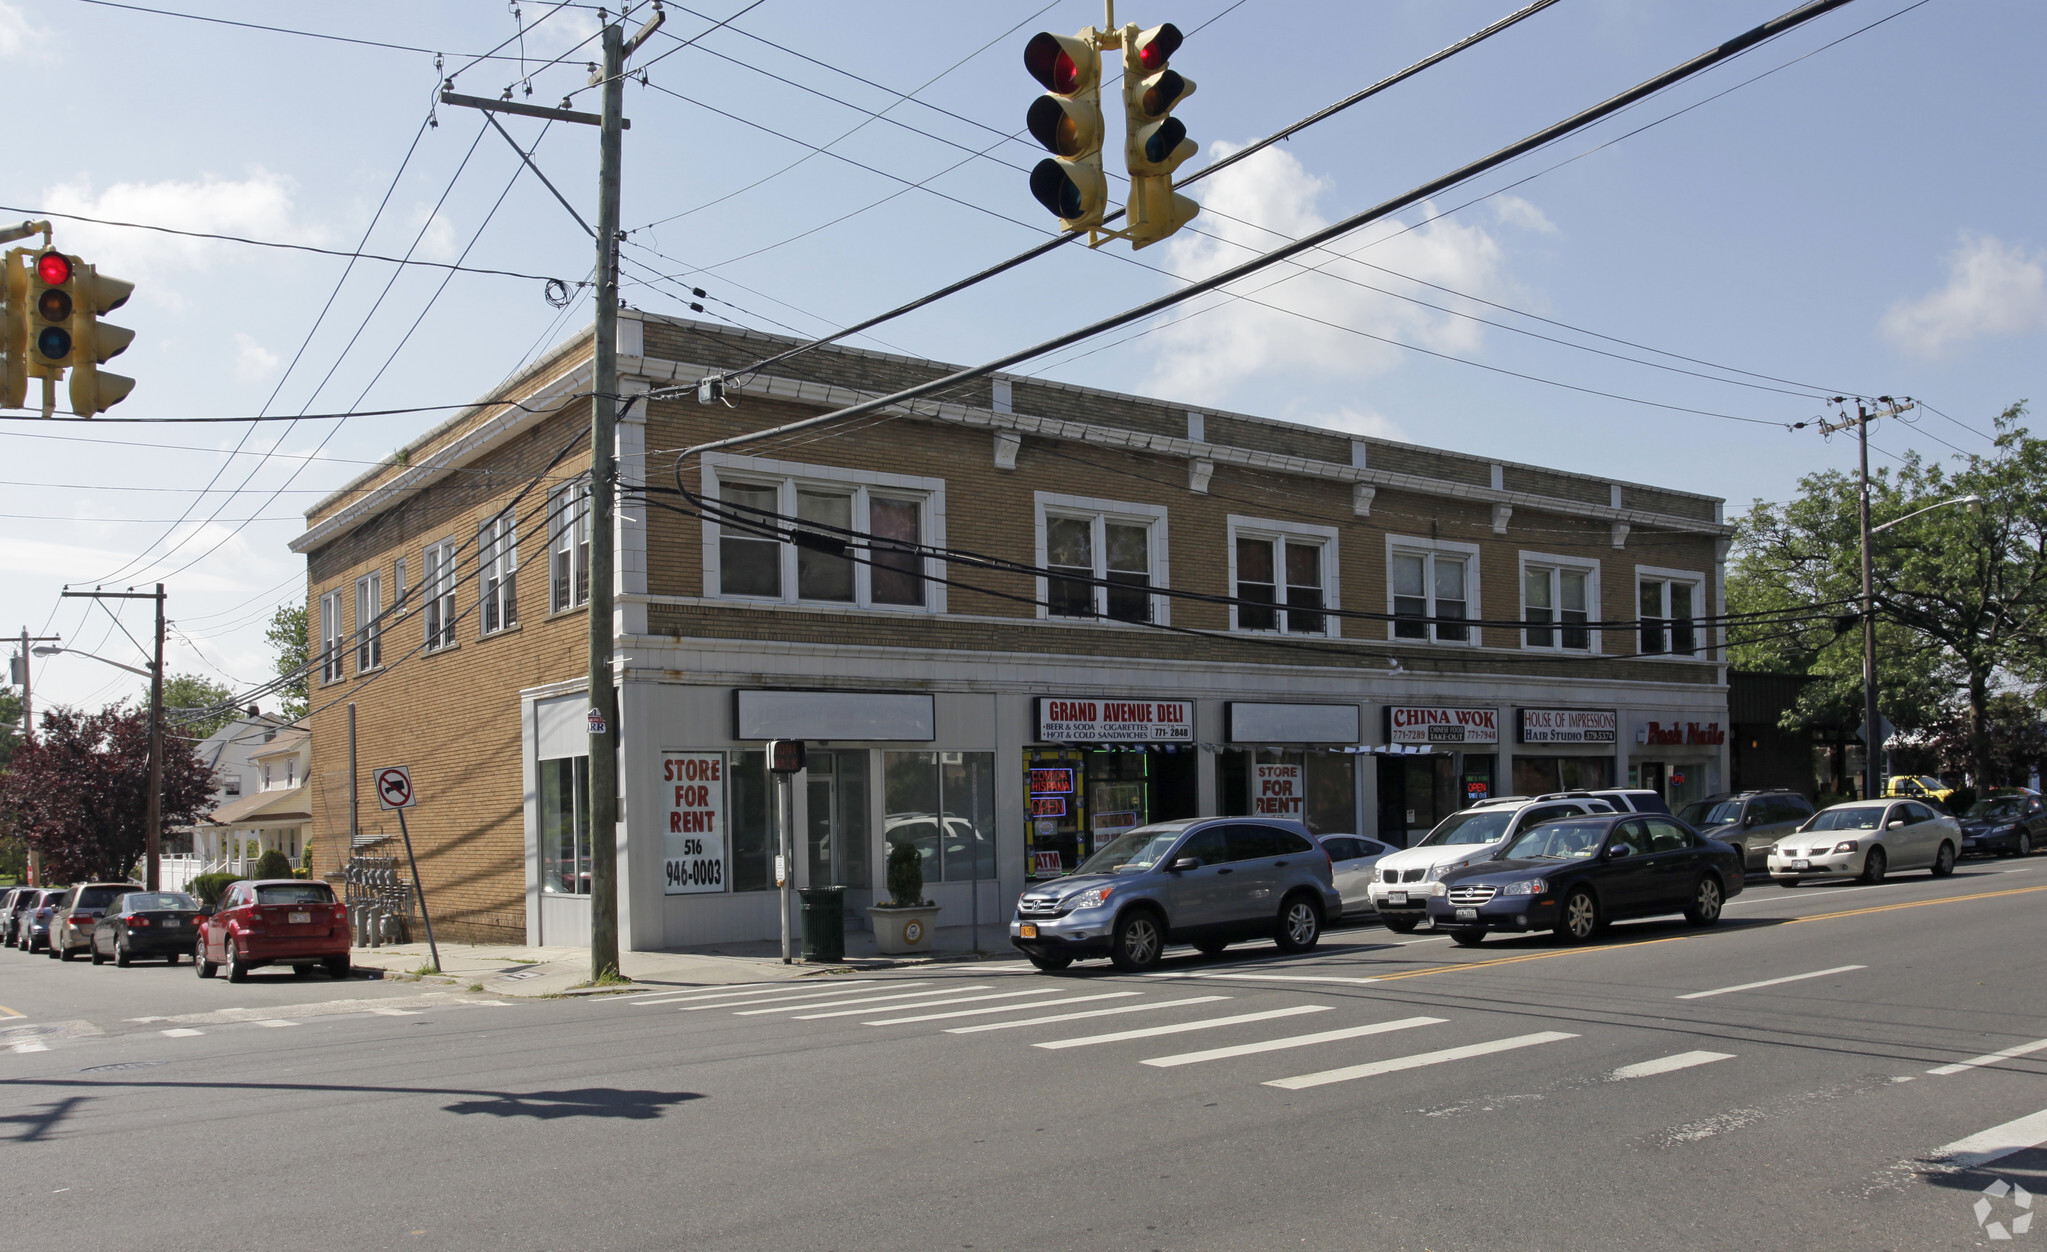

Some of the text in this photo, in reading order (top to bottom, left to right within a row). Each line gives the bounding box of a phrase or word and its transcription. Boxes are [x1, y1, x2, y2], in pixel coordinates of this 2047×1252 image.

[1049, 701, 1184, 723] GRAND AVENUE DELI
[1394, 709, 1496, 730] CHINA WOK
[1525, 711, 1615, 729] HOUSE OF IMPRESSIONS
[1045, 723, 1064, 731] BEER
[1073, 723, 1096, 731] SODA
[1046, 731, 1148, 739] HOT & COLD SANDWICHES
[1103, 723, 1149, 731] CIGARETTES
[1393, 730, 1426, 740] 771-7289
[1429, 726, 1464, 734] CHINESE FOOD
[1467, 730, 1497, 740] 771-7948
[1647, 721, 1725, 745] Posh Nails
[664, 759, 720, 782] STORE
[1031, 770, 1068, 781] COMIDA
[1258, 766, 1298, 778] STORE
[1031, 781, 1070, 792] HISPANA
[1262, 780, 1293, 797] FOR
[1467, 782, 1487, 792] OPEN
[675, 785, 709, 808] FOR
[1031, 799, 1064, 815] OPEN
[1256, 797, 1303, 813] RENT
[670, 811, 715, 833] RENT
[684, 838, 702, 855] 516
[1034, 852, 1060, 869] ATM
[665, 859, 722, 887] 946-0003
